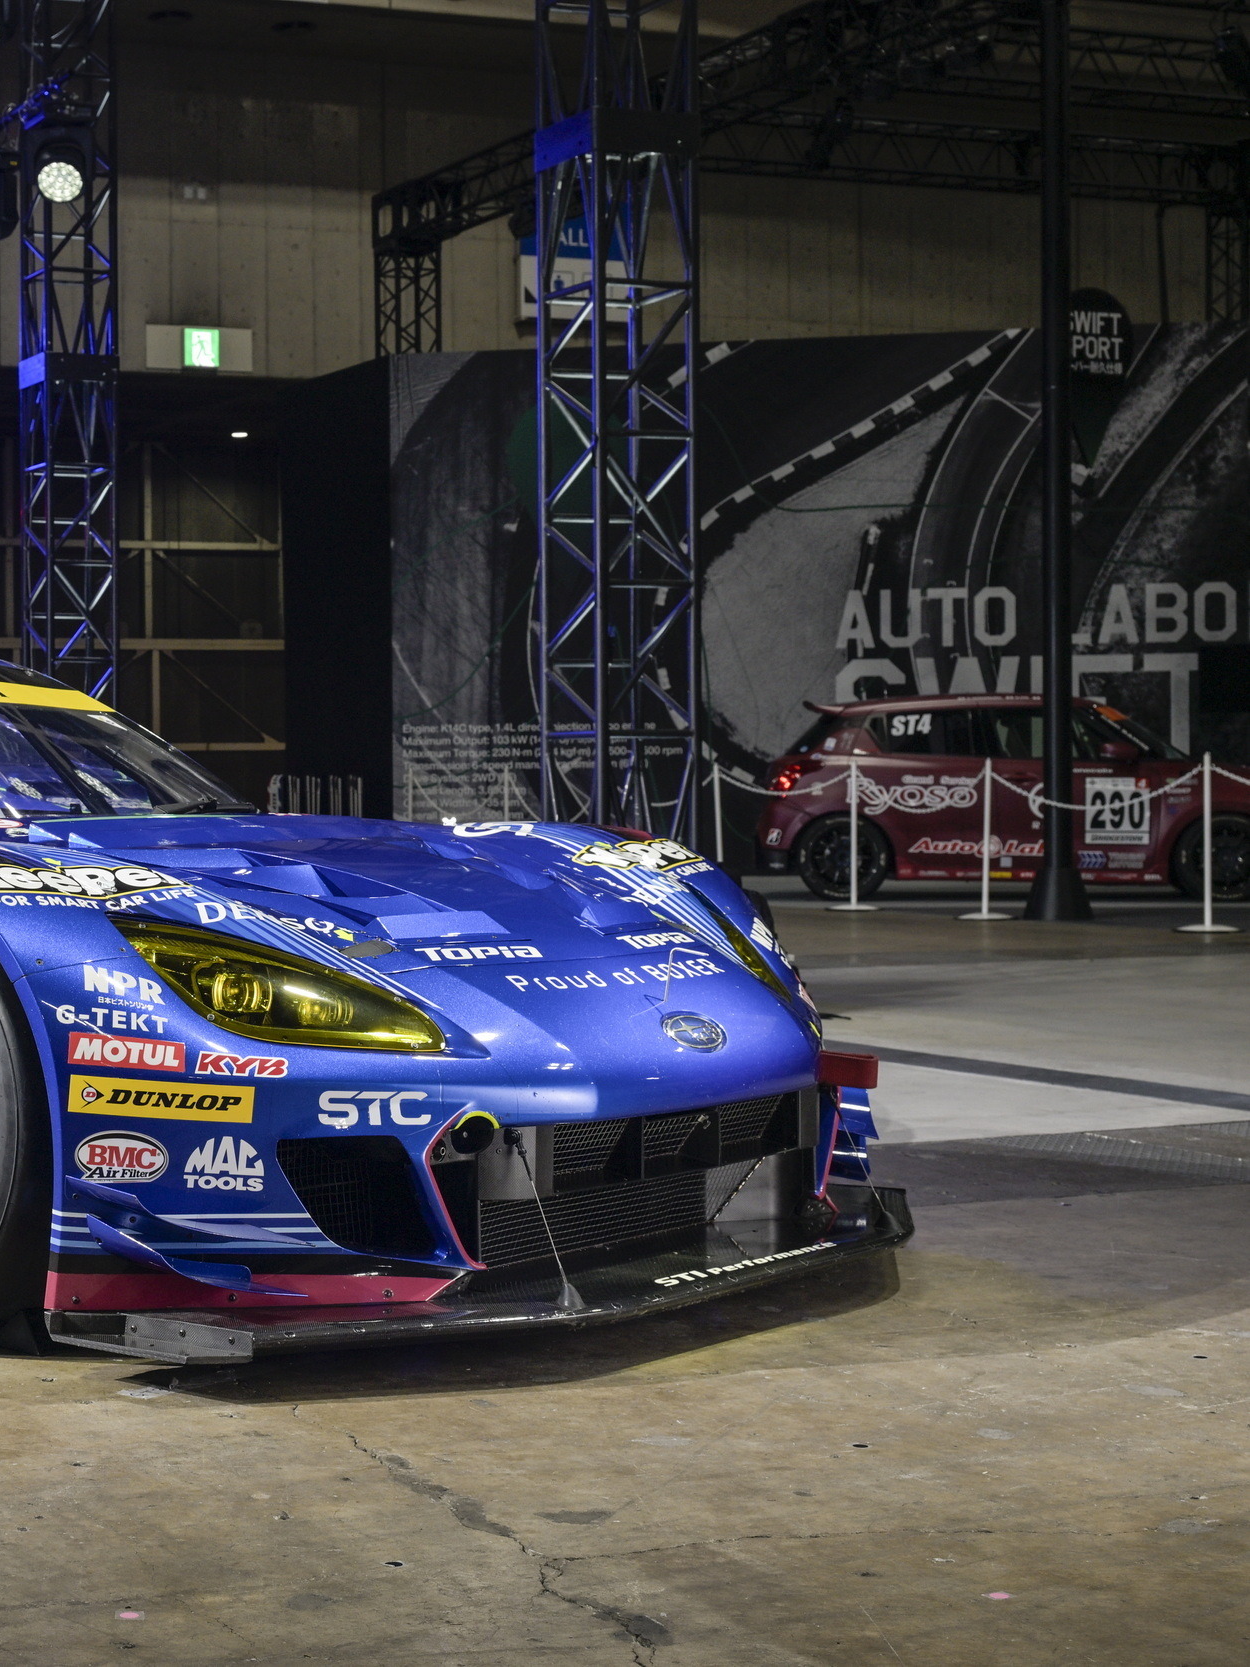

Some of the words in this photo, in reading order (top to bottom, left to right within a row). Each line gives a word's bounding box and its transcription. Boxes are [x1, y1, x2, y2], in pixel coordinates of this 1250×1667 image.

[1070, 310, 1122, 335] WIFT
[1072, 335, 1123, 360] PORT
[836, 586, 1017, 649] AUTO
[1072, 582, 1237, 645] ABO
[890, 713, 933, 737] ST4
[1091, 791, 1144, 829] 290
[908, 837, 977, 854] Auto
[37, 895, 99, 910] SMART
[104, 893, 147, 912] CAR
[148, 886, 198, 902] LIFE
[82, 963, 166, 1006] NPR
[504, 970, 608, 993] Proud
[612, 966, 646, 985] of
[640, 957, 725, 982] BOXER
[56, 1004, 168, 1034] G-TEKT
[72, 1037, 180, 1067] MOTUL
[194, 1050, 289, 1079] KYB
[105, 1088, 242, 1112] DUNLOP
[317, 1090, 432, 1127] STC
[86, 1143, 157, 1169] BMC
[184, 1135, 265, 1177] MAC
[85, 1166, 119, 1179] Air
[183, 1175, 264, 1192] TOOLS
[653, 1269, 709, 1288] STI
[705, 1241, 838, 1276] Performance
